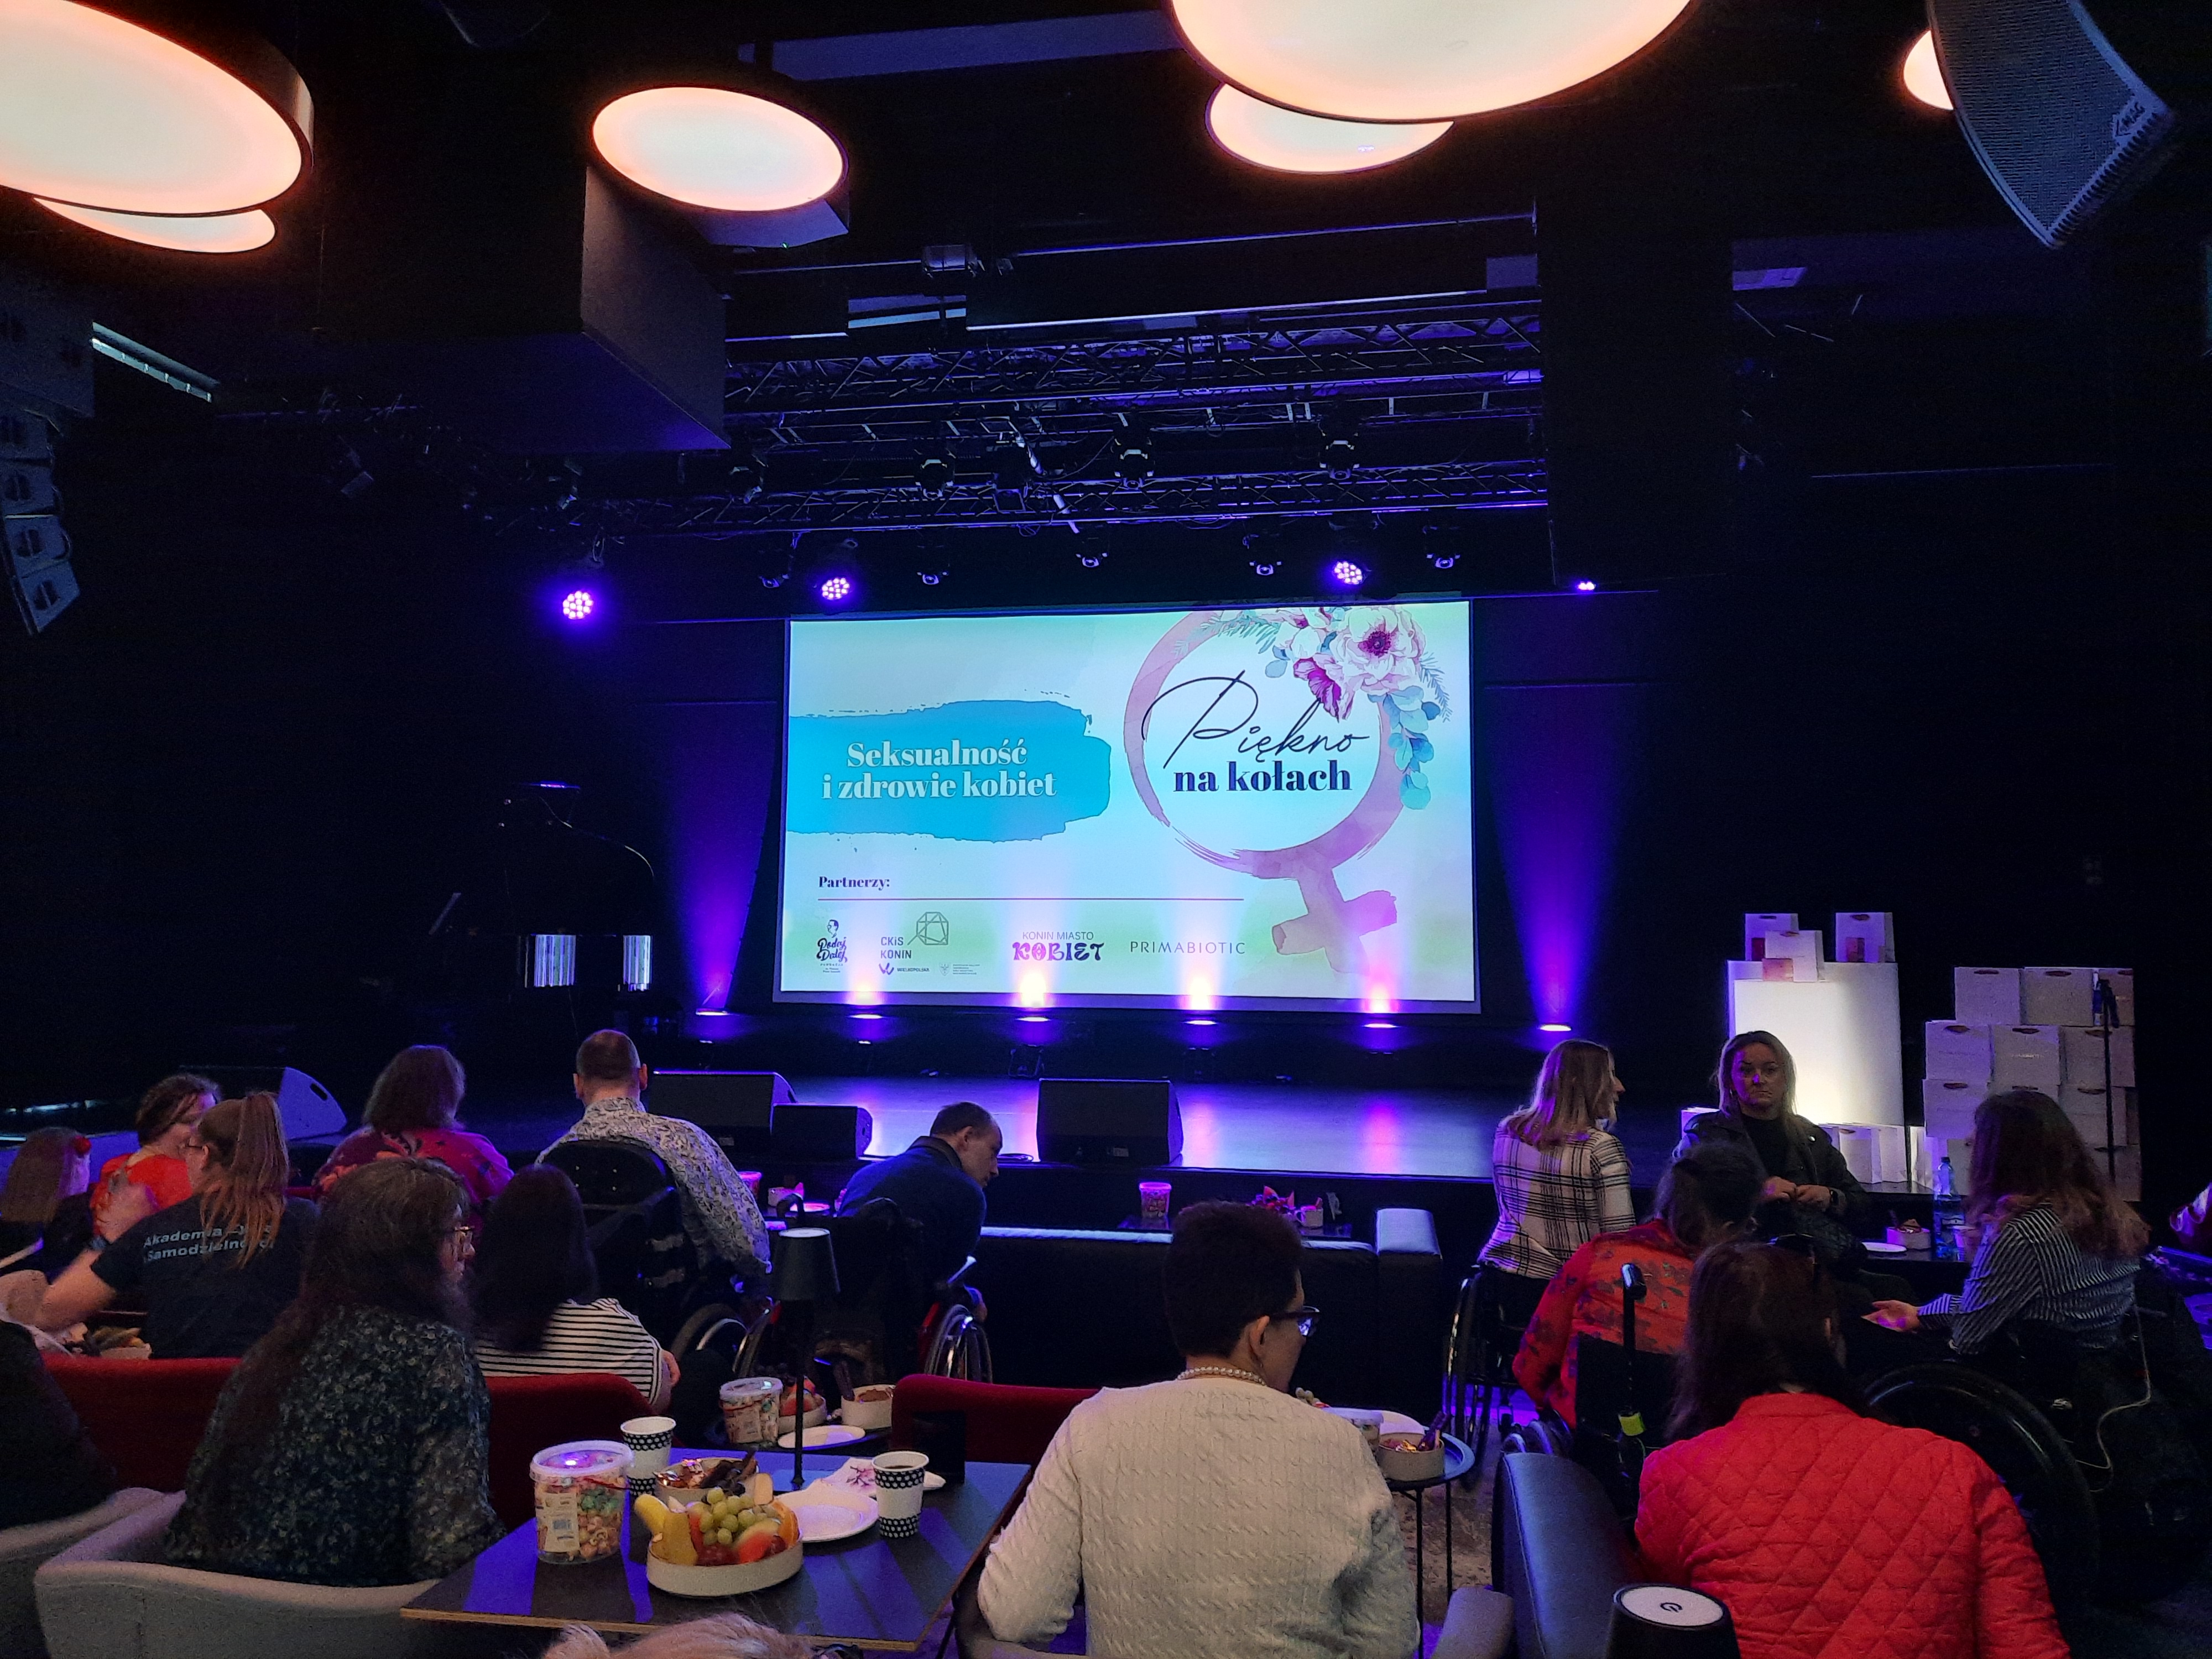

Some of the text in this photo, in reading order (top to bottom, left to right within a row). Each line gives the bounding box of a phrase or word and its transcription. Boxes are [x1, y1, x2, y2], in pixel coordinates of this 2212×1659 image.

[1141, 670, 1370, 769] Piękno
[847, 738, 1027, 767] Seksualność
[821, 770, 1057, 799] i zdrowie kobiet
[1173, 760, 1352, 792] na kołach
[818, 876, 890, 891] Partnerzy:
[1022, 931, 1094, 940] KONIN MIASTO
[880, 950, 912, 959] KONIN
[1012, 942, 1105, 961] KOBIET
[1130, 941, 1245, 954] PRIMABIOTIC
